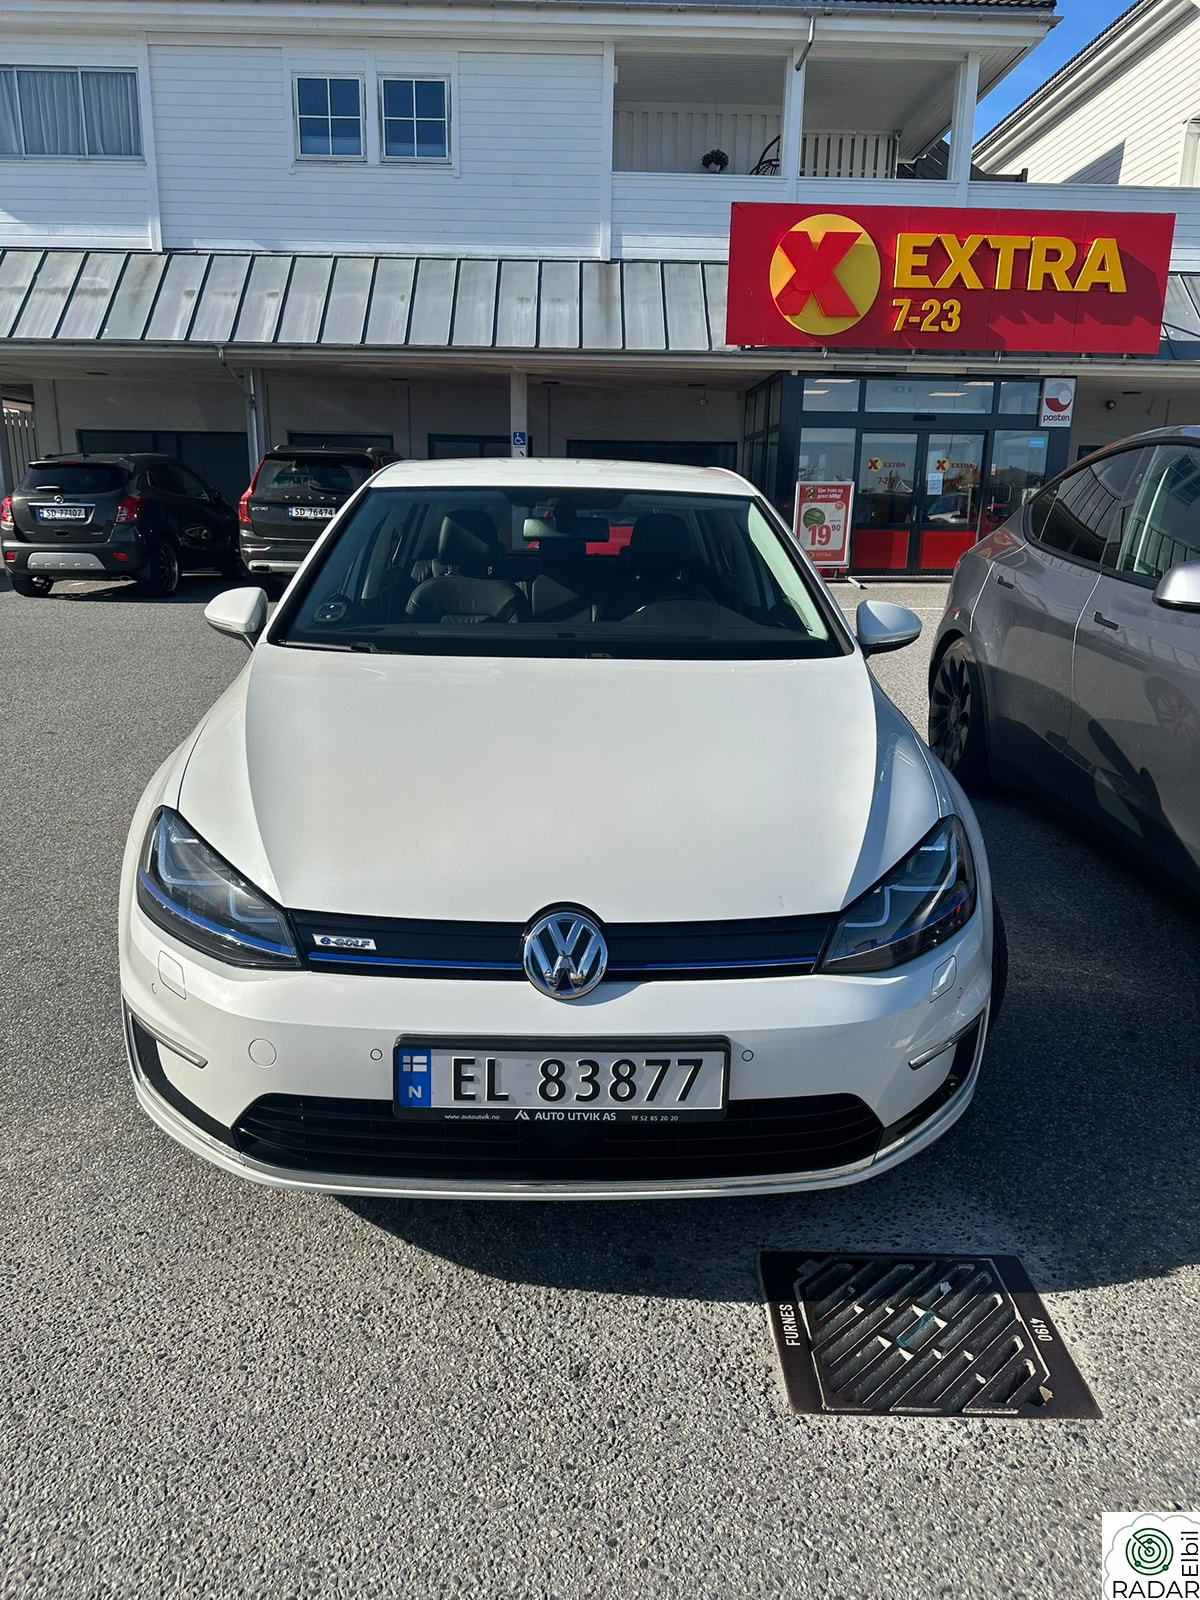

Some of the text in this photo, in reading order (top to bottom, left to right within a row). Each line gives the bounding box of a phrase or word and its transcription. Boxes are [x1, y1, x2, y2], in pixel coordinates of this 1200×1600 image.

[893, 232, 1127, 293] EXTRA
[891, 298, 961, 333] 7-23
[1043, 414, 1070, 422] posten
[46, 508, 82, 517] SD 77107
[294, 507, 333, 517] SD 76474
[807, 524, 841, 546] 19 90
[452, 1057, 703, 1102] EL 83877
[408, 1085, 423, 1098] N
[444, 1113, 500, 1121] www.autoutvik.no
[534, 1112, 617, 1121] AUTO UTVIK AS
[779, 1304, 801, 1346] FURNES
[1030, 1317, 1053, 1341] 4190
